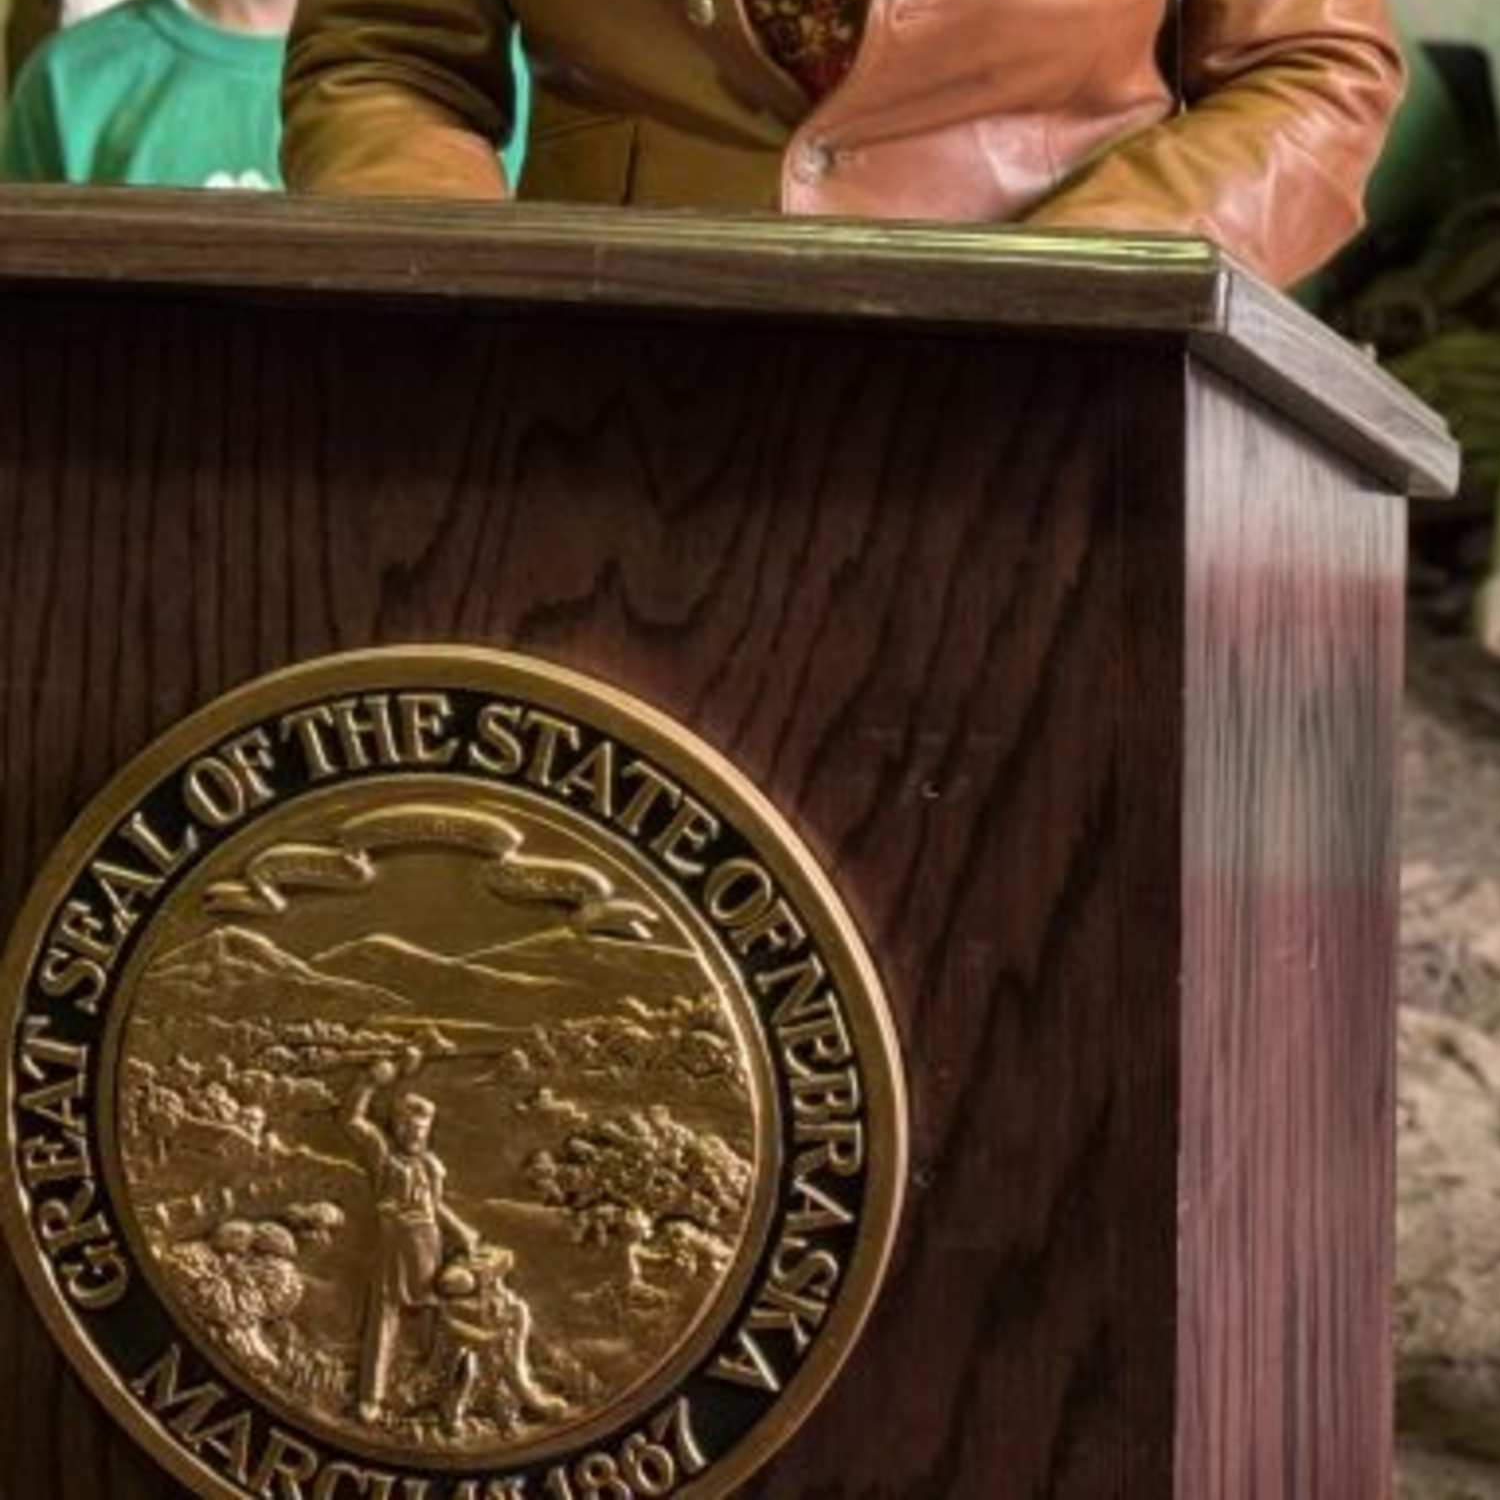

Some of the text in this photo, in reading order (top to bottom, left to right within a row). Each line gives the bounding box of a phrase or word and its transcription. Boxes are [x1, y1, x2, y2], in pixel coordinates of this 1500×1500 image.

[19, 693, 863, 1393] GREAT SEAL OF THE STATE OF NEBRASKA
